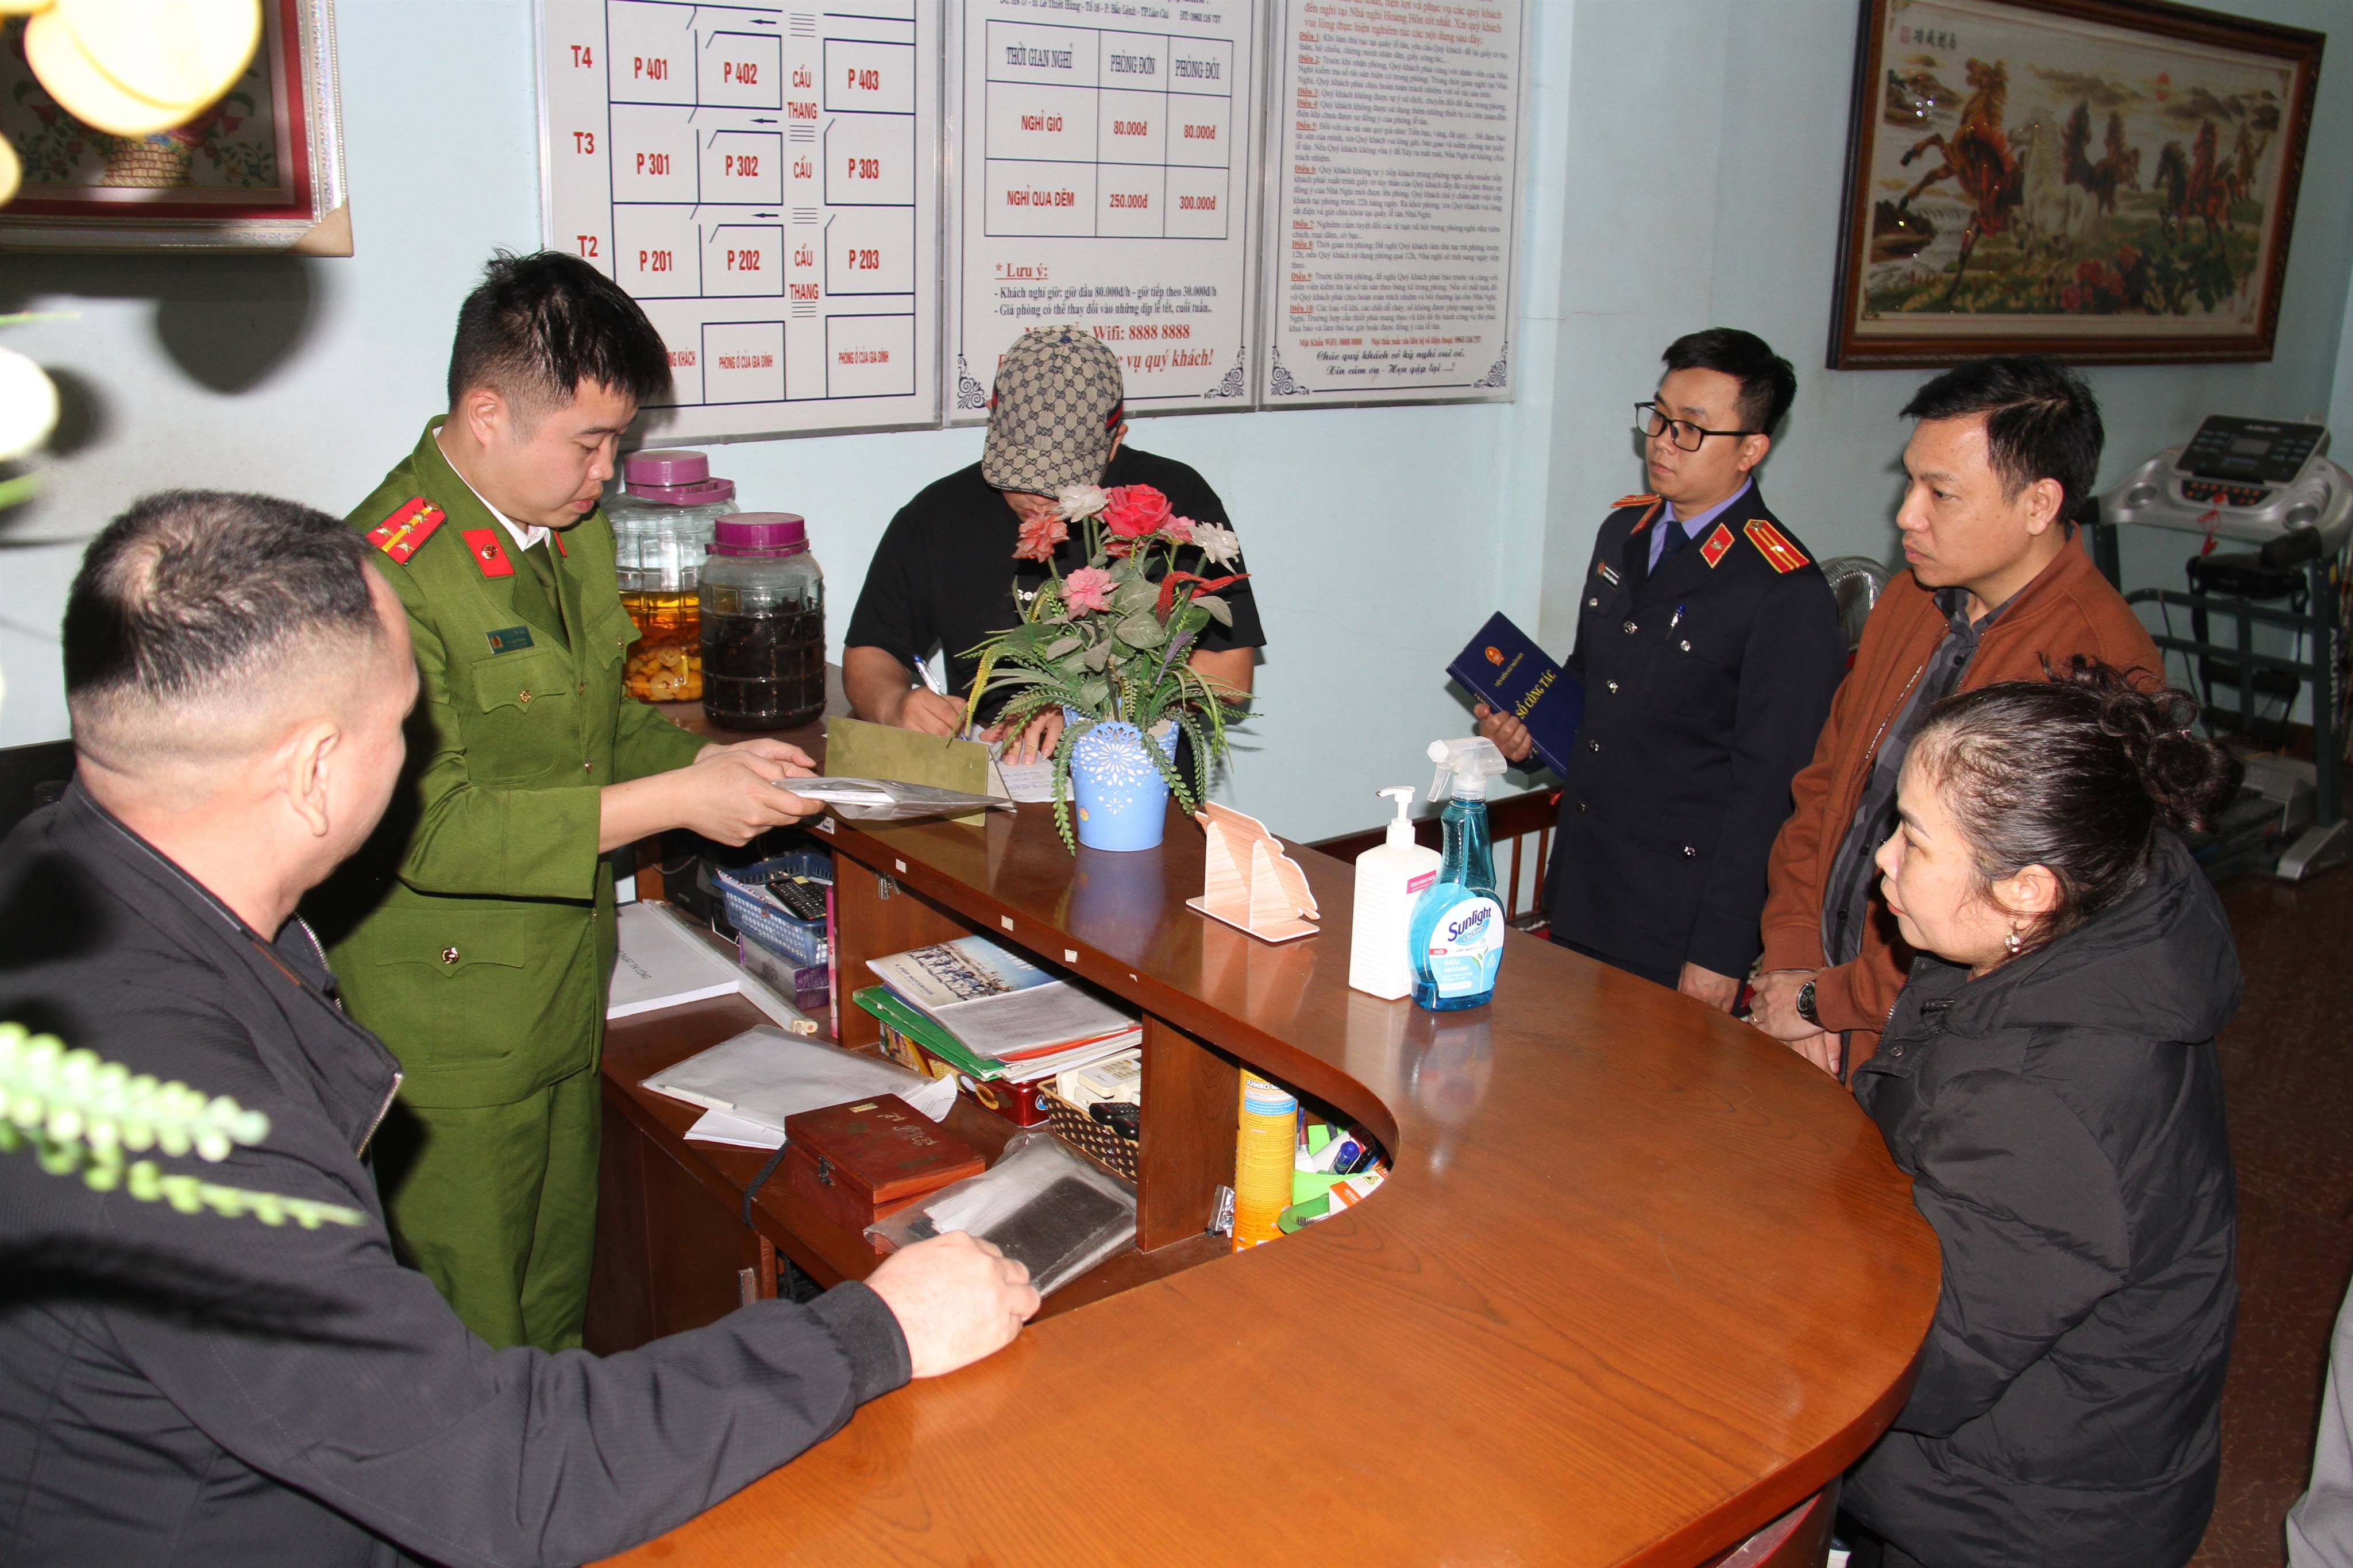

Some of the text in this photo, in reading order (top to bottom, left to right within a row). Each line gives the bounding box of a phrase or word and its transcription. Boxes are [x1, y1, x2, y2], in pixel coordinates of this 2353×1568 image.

[1065, 1, 1080, 13] Hùng
[571, 45, 592, 68] T4
[1006, 41, 1073, 68] THỜI GIAN NGHỈ
[1110, 50, 1155, 75] PHÒNG ĐƠN
[634, 57, 669, 80] P 401
[724, 62, 757, 85] P 402
[1175, 55, 1220, 80] PHÒNG ĐÔI
[848, 68, 879, 91] P 403
[787, 102, 817, 119] THANG
[1021, 110, 1062, 132] NGHỈ GIỜ
[1113, 121, 1147, 136] 80.000đ
[1183, 124, 1216, 140] 80.000đ
[573, 132, 595, 155] T3
[637, 153, 670, 176] P 301
[726, 155, 758, 177] P 302
[848, 158, 879, 179] P 303
[1006, 184, 1075, 207] NGHỈ QUA ĐÊM
[1109, 193, 1148, 209] 250.000đ
[1179, 195, 1216, 210] 300.000đ
[577, 235, 598, 257] T2
[639, 250, 673, 272] P 201
[727, 250, 760, 271] P 202
[848, 249, 880, 270] P 203
[1006, 263, 1048, 281] Lưu ý:
[789, 283, 819, 300] THANG
[1000, 286, 1025, 298] Khách
[1064, 287, 1077, 300] giờ
[1137, 286, 1149, 300] giờ
[1166, 285, 1182, 298] theo
[1000, 304, 1014, 315] Giá
[1016, 303, 1041, 318] phòng
[1043, 304, 1051, 315] có
[1067, 304, 1084, 317] thay
[1100, 303, 1113, 314] vào
[1115, 302, 1139, 316] những
[1140, 303, 1152, 316] dịp
[1093, 323, 1190, 341] Wifi: 8888 8888
[678, 346, 696, 366] KHÁCH
[752, 355, 760, 368] GIA
[869, 351, 877, 363] GIA
[1127, 355, 1141, 373] vụ
[1145, 349, 1169, 373] quý
[1171, 348, 1214, 366] khách!
[1362, 350, 1388, 360] khách
[1515, 669, 1557, 720] SỔ CÔNG TÁC
[1448, 906, 1492, 942] Sunlight
[1443, 965, 1469, 974] NHANH
[908, 975, 934, 995] NOTEBOOK
[1246, 1079, 1270, 1090] JUMBO
